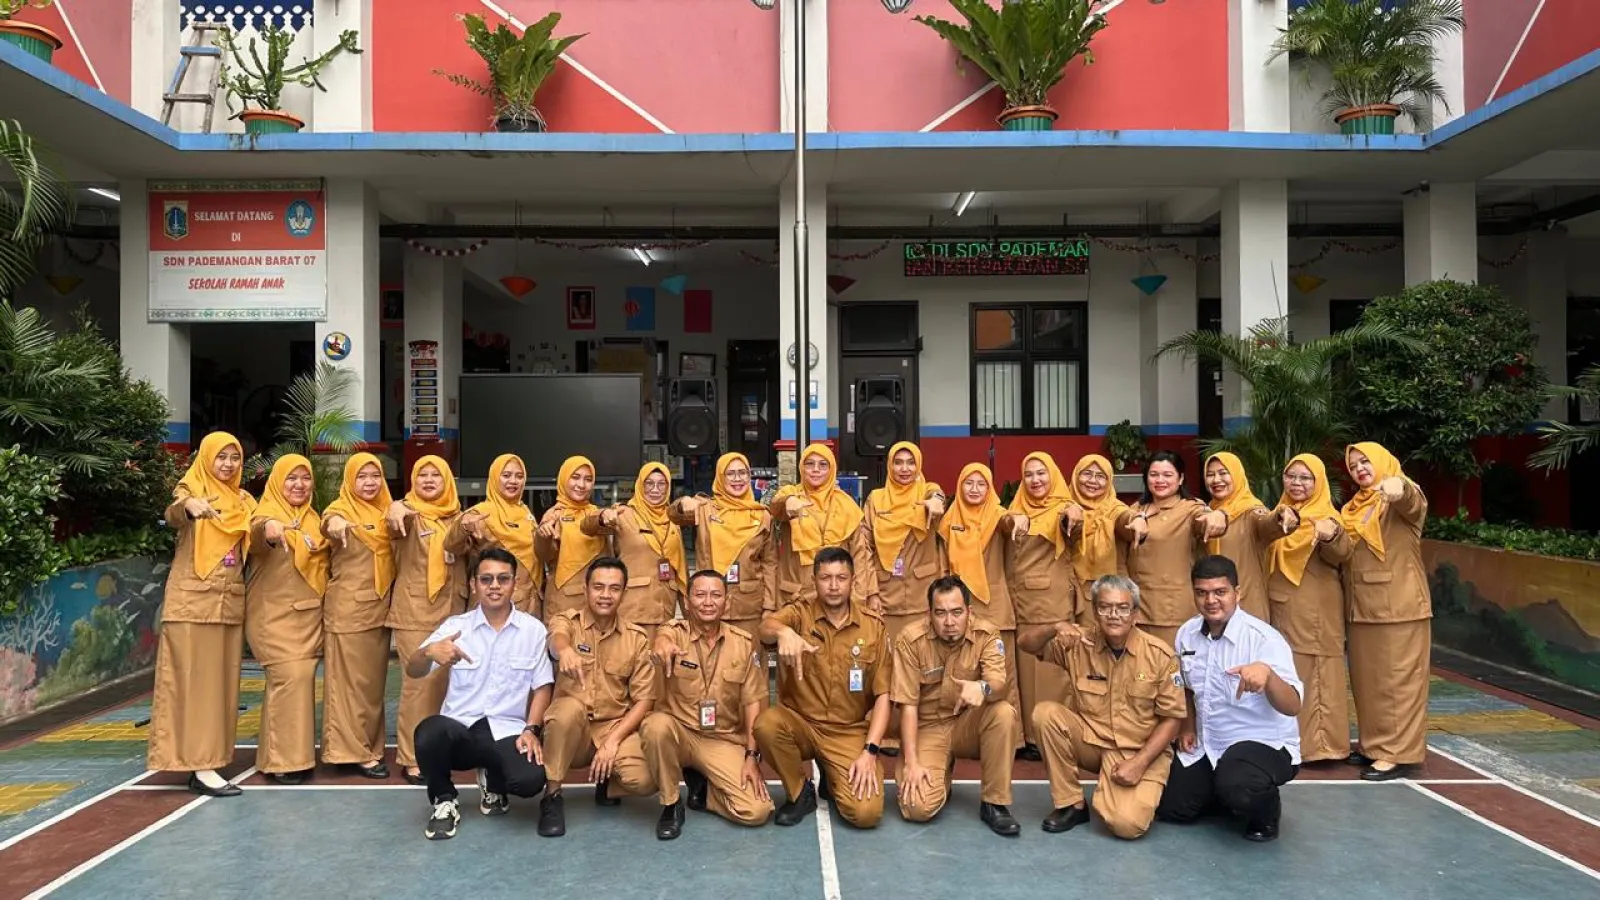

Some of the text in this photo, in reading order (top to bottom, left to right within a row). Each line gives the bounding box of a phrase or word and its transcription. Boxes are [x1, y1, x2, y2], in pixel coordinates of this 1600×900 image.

[194, 210, 275, 221] SELAMAT DATANG
[231, 232, 241, 242] DI
[163, 256, 316, 266] SDN PADEMANGAN BARAT 07
[188, 277, 284, 290] SEKOLAH RAMAH ANAK
